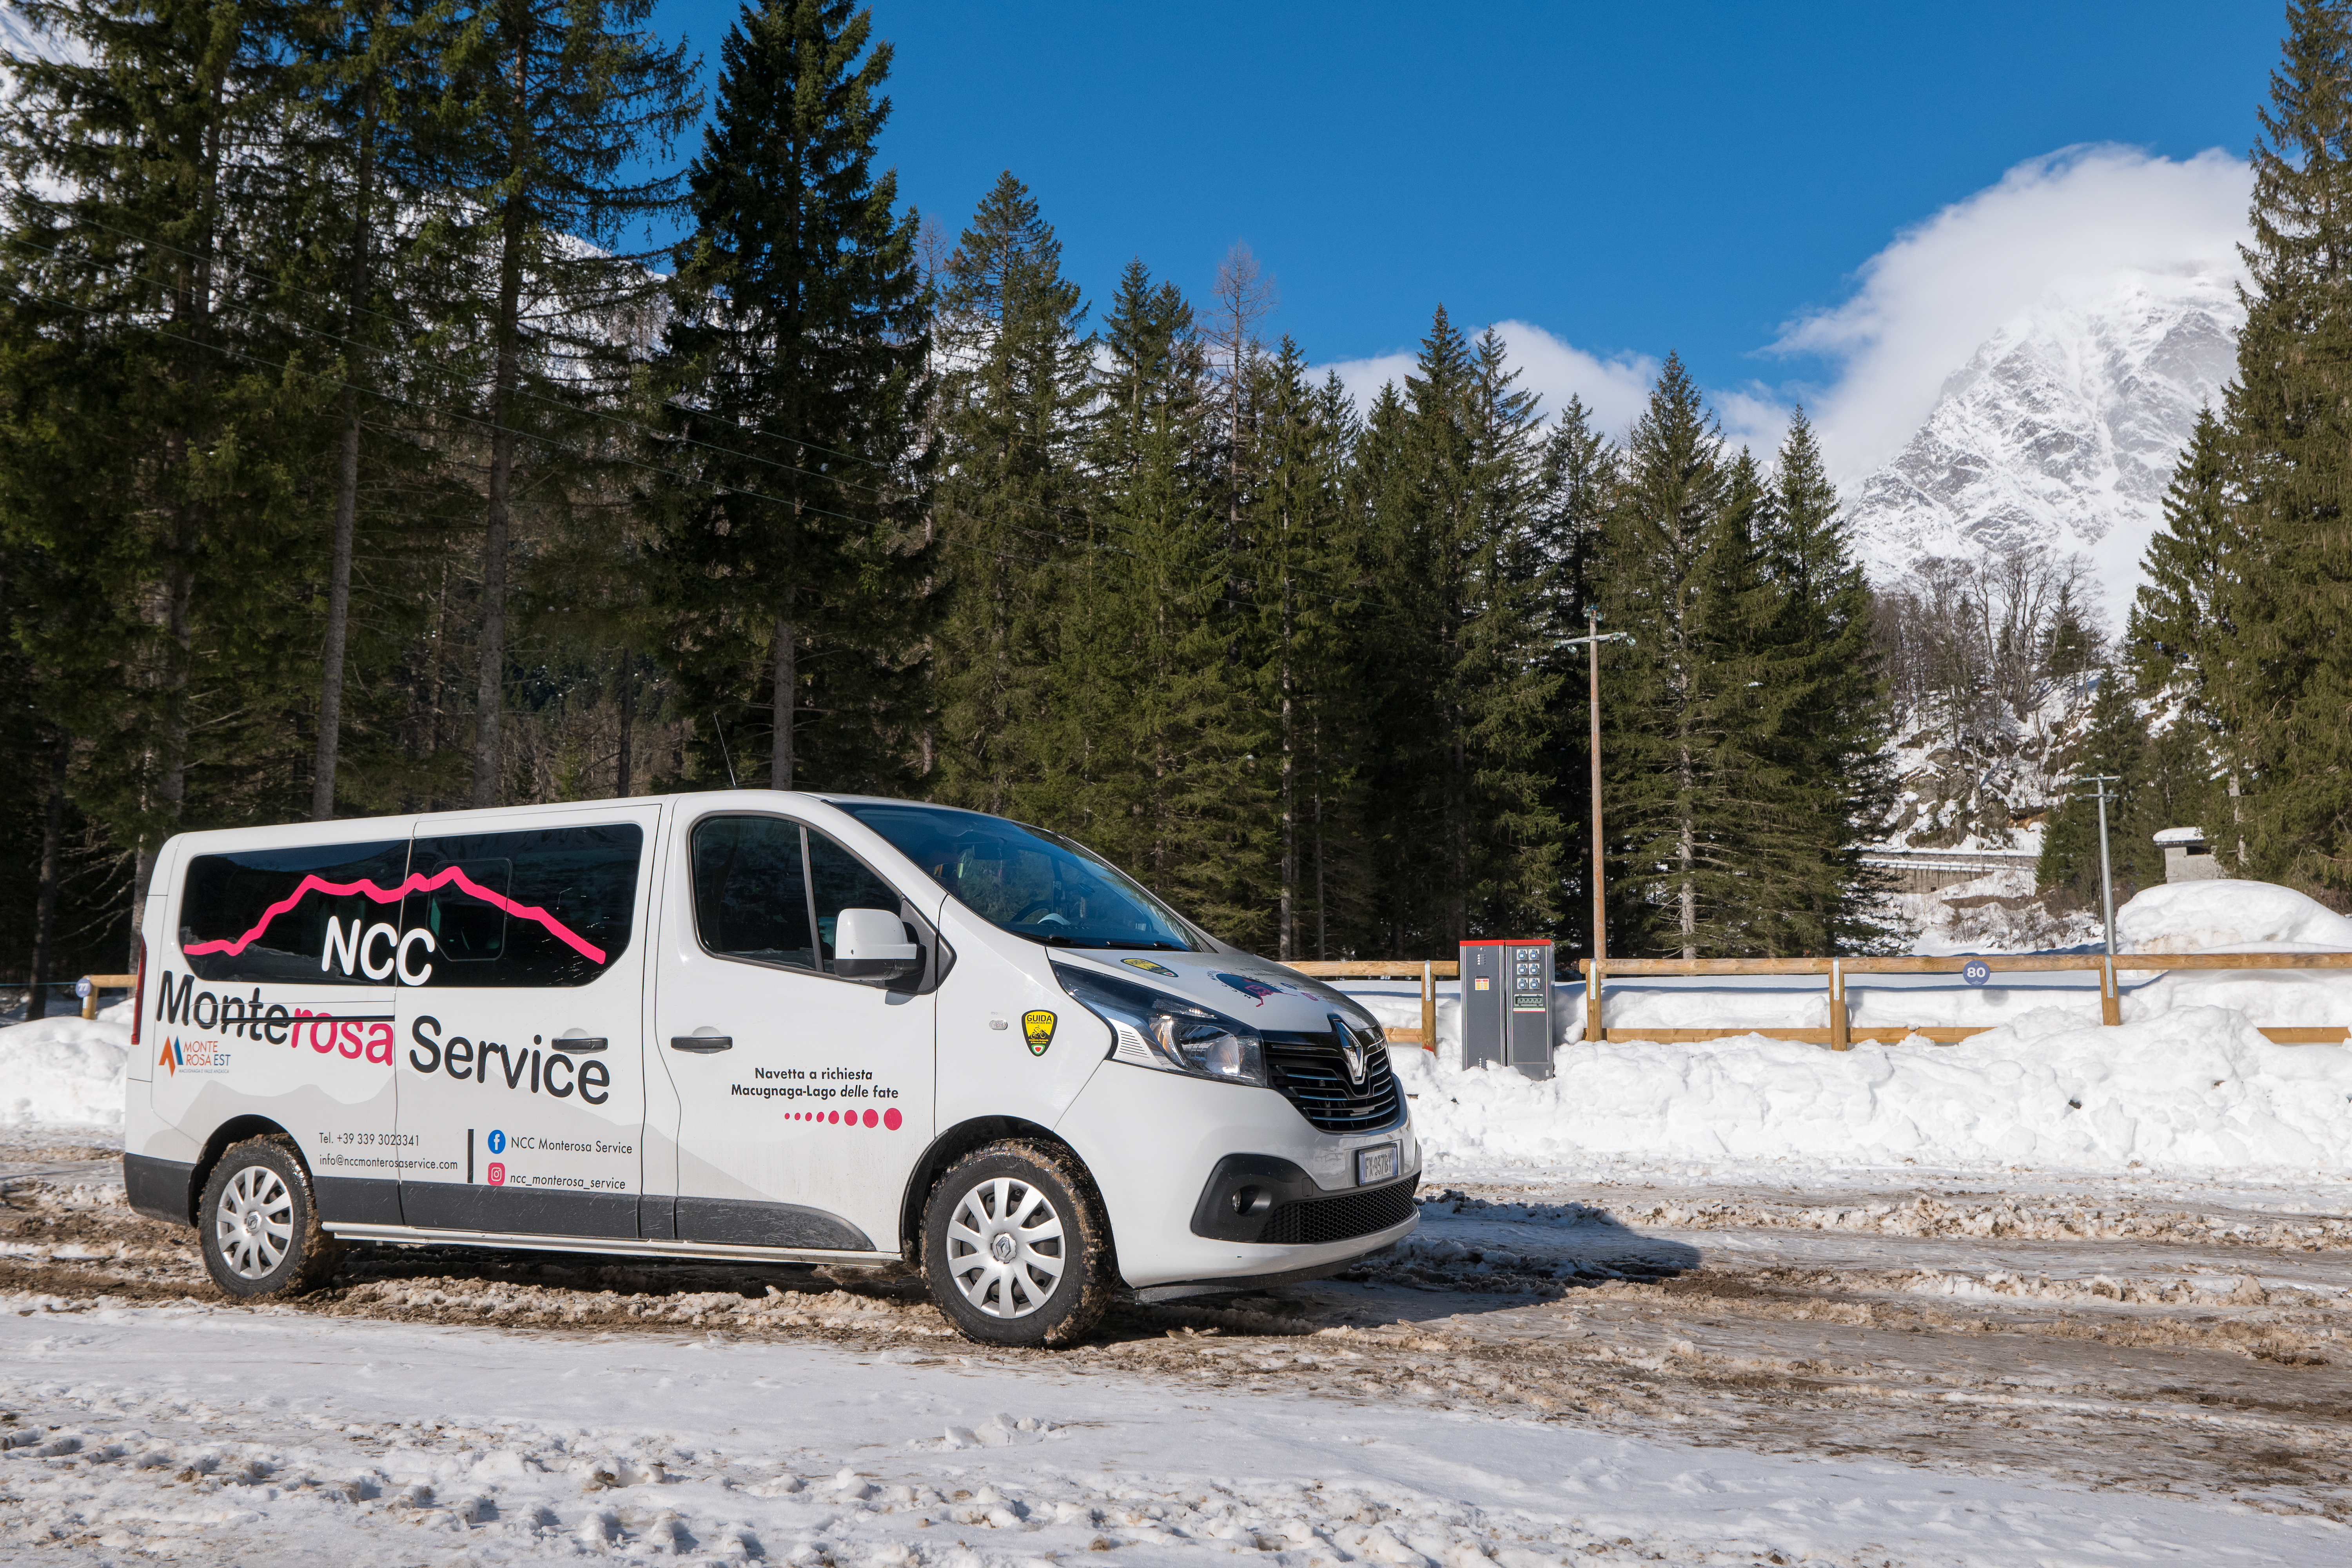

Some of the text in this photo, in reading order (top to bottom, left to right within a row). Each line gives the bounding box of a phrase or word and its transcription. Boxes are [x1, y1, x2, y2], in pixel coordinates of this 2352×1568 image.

[321, 916, 435, 986] NCC
[1967, 967, 1986, 978] 80
[78, 983, 89, 991] 77
[156, 970, 610, 1105] Monterosa Service
[183, 1041, 218, 1053] MONTE
[186, 1054, 231, 1066] ROSA EST
[755, 1067, 873, 1080] Navetta a richiesta
[731, 1084, 898, 1100] Macugnaga-Lago delle fate
[319, 1132, 419, 1146] Tel. +39 339 3023341
[511, 1136, 632, 1154] NCC Monterosa Service
[319, 1153, 458, 1170] info@nccmonterosaservice.com
[1365, 1152, 1392, 1178] FX 937BY
[510, 1175, 626, 1190] ncc_monterosa_service
